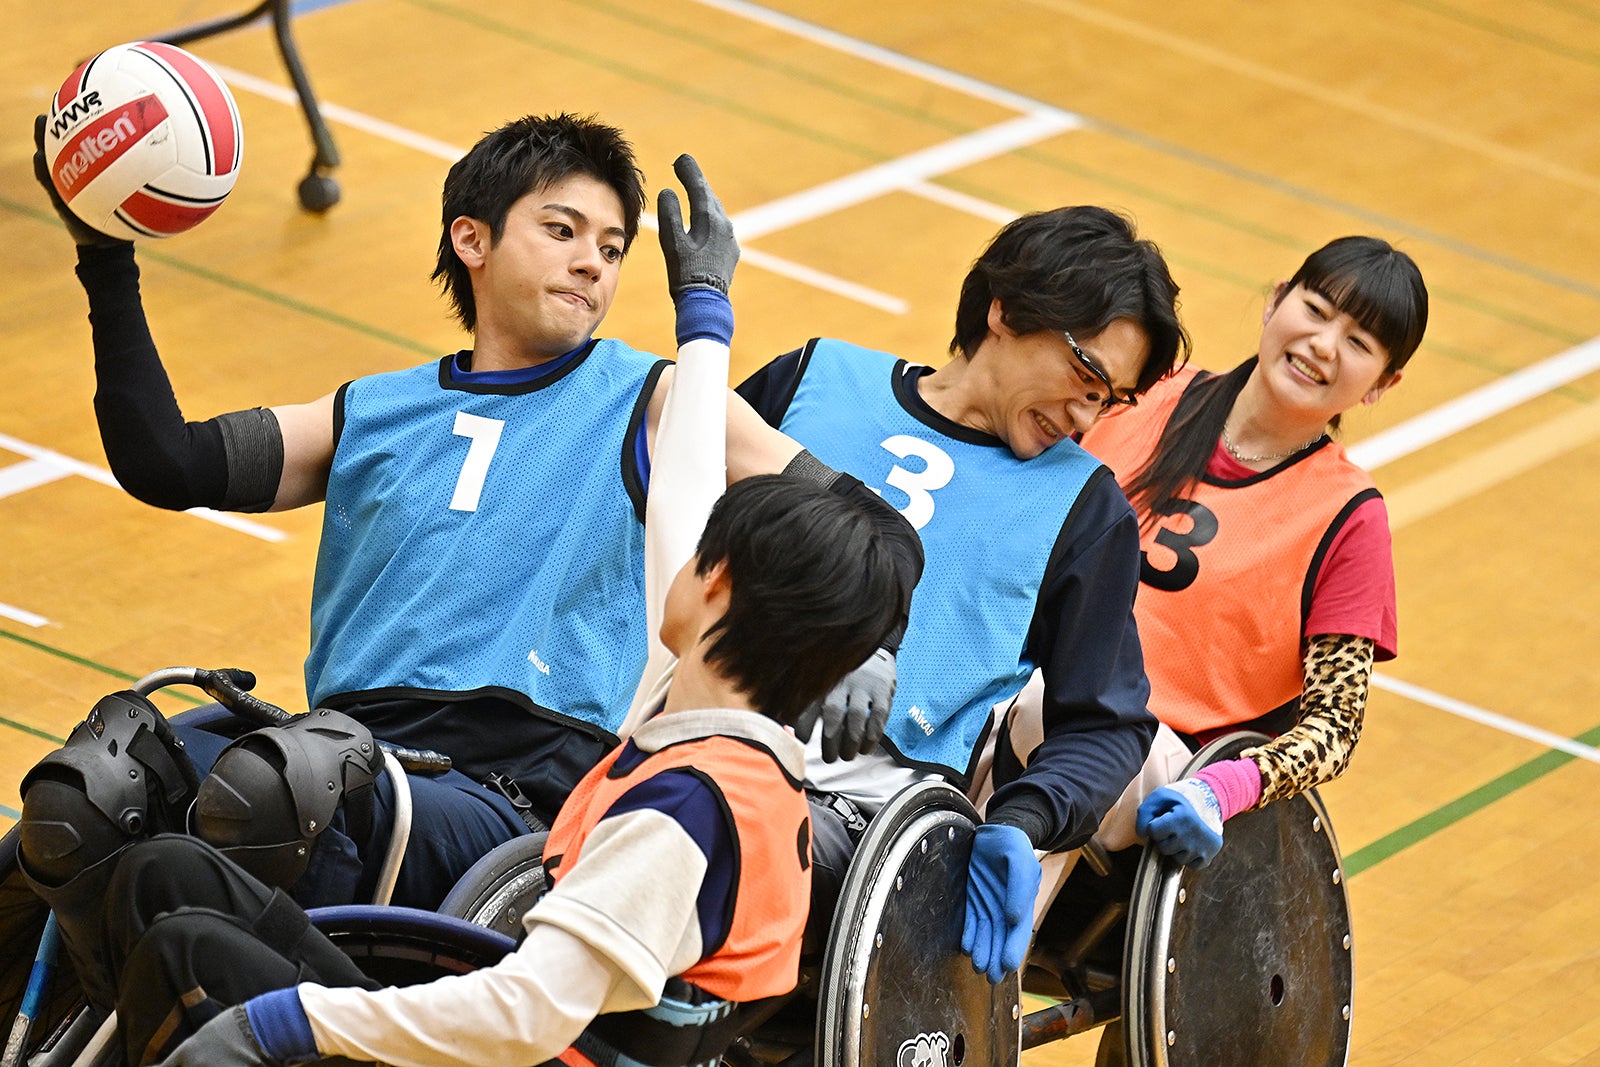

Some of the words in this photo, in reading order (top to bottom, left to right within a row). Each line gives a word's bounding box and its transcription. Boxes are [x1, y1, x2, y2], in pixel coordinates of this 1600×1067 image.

[60, 111, 137, 191] molten
[865, 434, 955, 531] 3
[1140, 498, 1219, 592] 3
